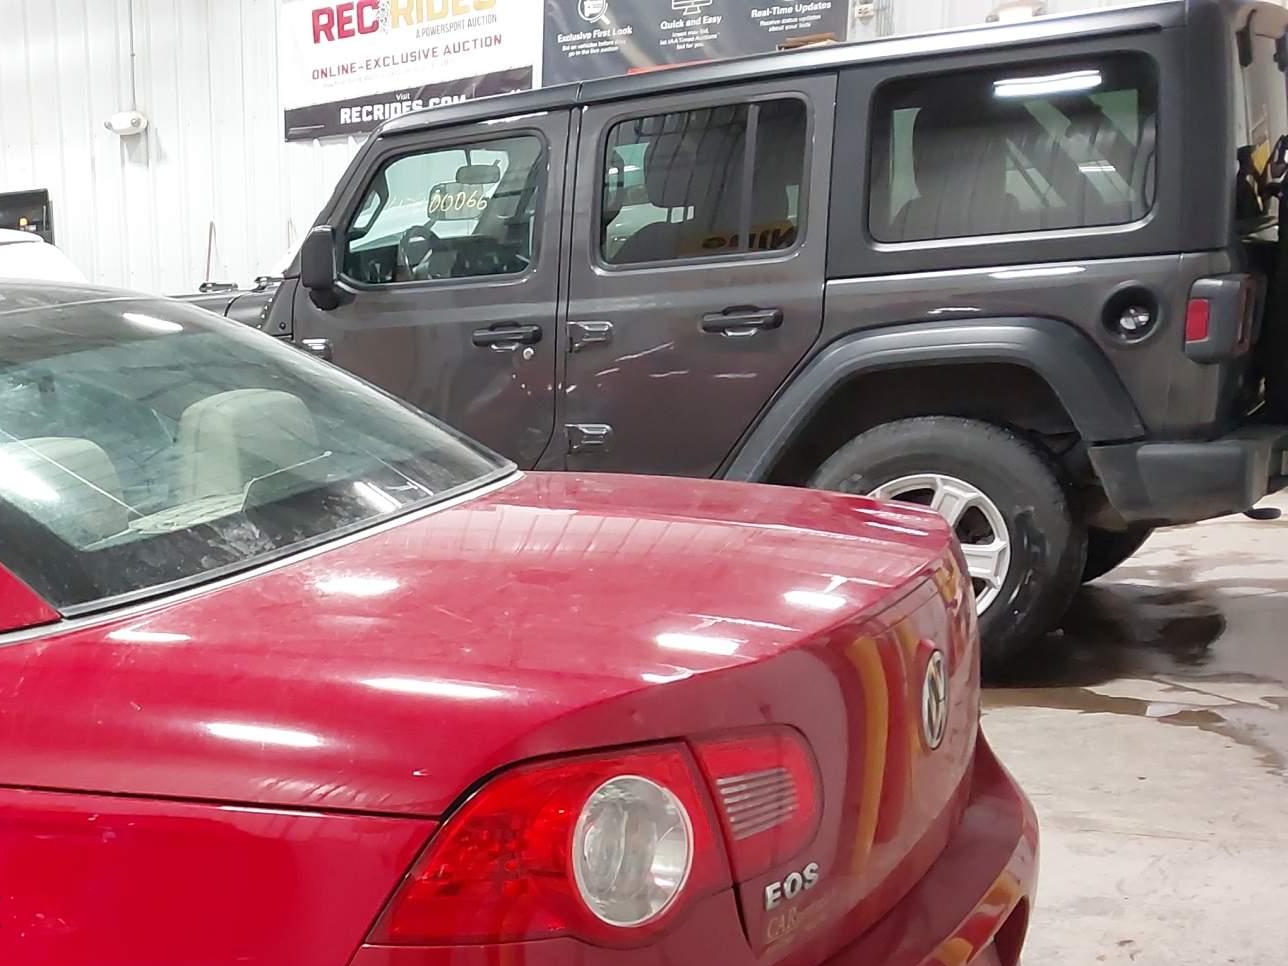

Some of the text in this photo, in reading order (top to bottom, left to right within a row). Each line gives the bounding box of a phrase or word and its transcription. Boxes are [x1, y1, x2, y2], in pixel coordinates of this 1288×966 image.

[751, 2, 831, 17] Real-Time Updates
[312, 0, 379, 44] REC
[421, 22, 466, 38] POWERSPORT
[467, 14, 498, 29] AUCTION
[557, 25, 633, 43] Exclusive First Look
[660, 15, 722, 30] Quick and Easy
[311, 47, 439, 81] ONLINE-EXCLUSIVE
[443, 34, 503, 56] AUCTION
[340, 93, 468, 125] RECRIDESCOM
[395, 92, 411, 102] Visit
[765, 862, 819, 911] EOS
